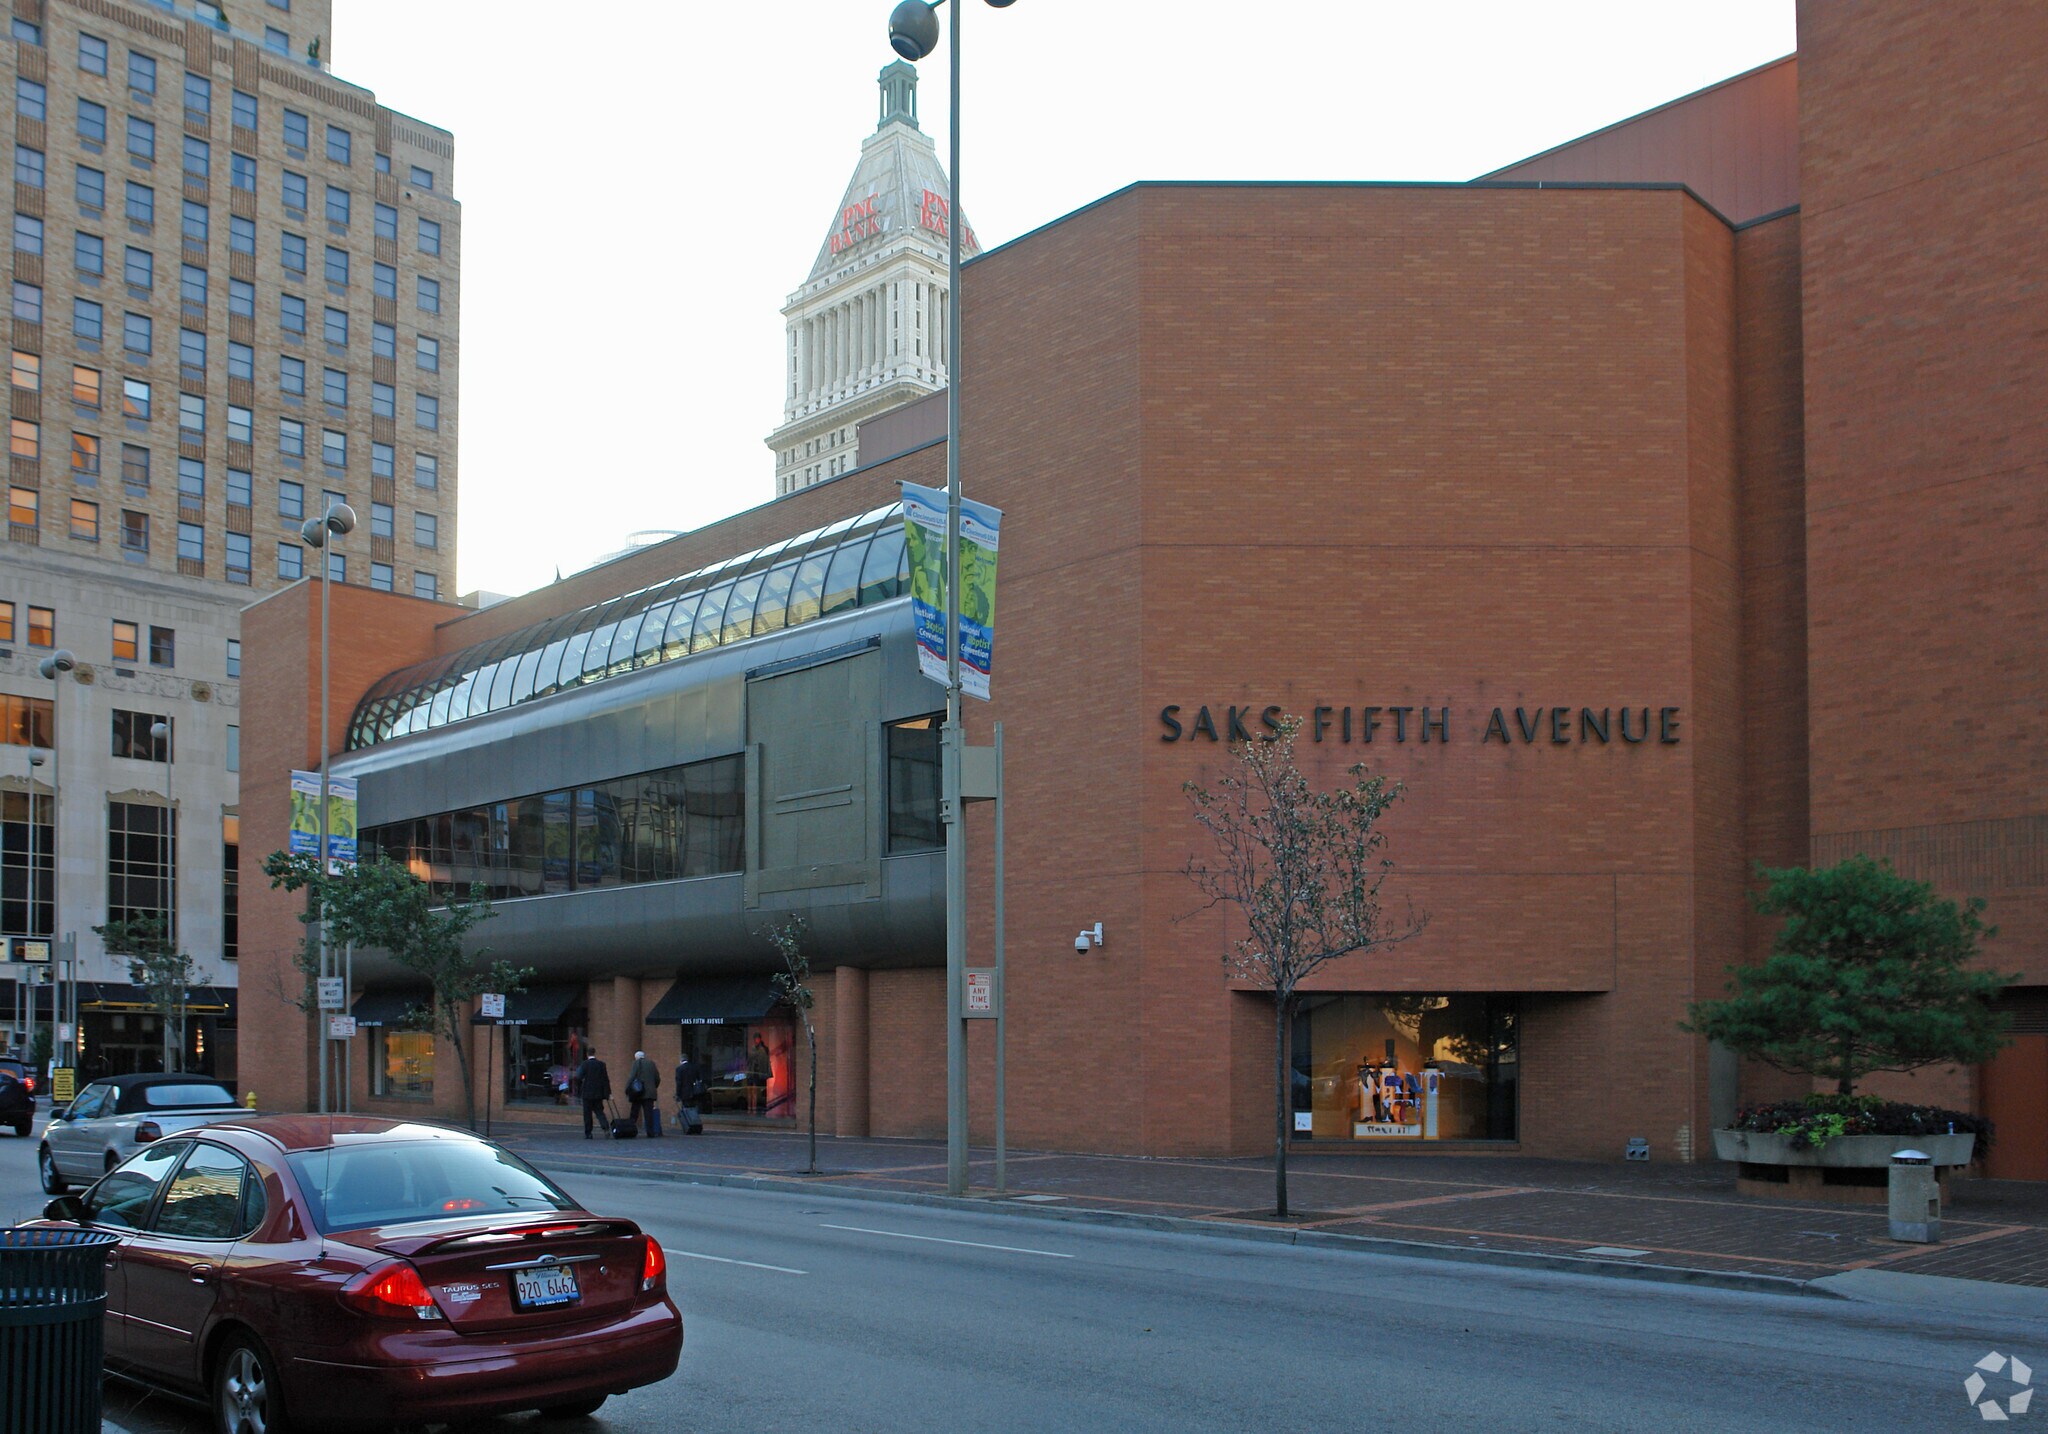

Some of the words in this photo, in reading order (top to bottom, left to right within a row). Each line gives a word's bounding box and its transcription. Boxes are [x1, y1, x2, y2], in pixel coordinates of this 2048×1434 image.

[842, 192, 879, 228] PNC
[830, 213, 881, 255] BANK
[921, 207, 979, 250] BAK
[960, 643, 990, 659] Convention
[967, 635, 991, 650] Baptist
[1161, 705, 1282, 743] SAKS
[1314, 706, 1450, 743] FIFTH
[1483, 706, 1681, 743] AVENUE
[971, 995, 988, 1003] TIME
[442, 1284, 480, 1294] TAURUS
[518, 1281, 542, 1300] 920
[547, 1277, 577, 1296] 6462
